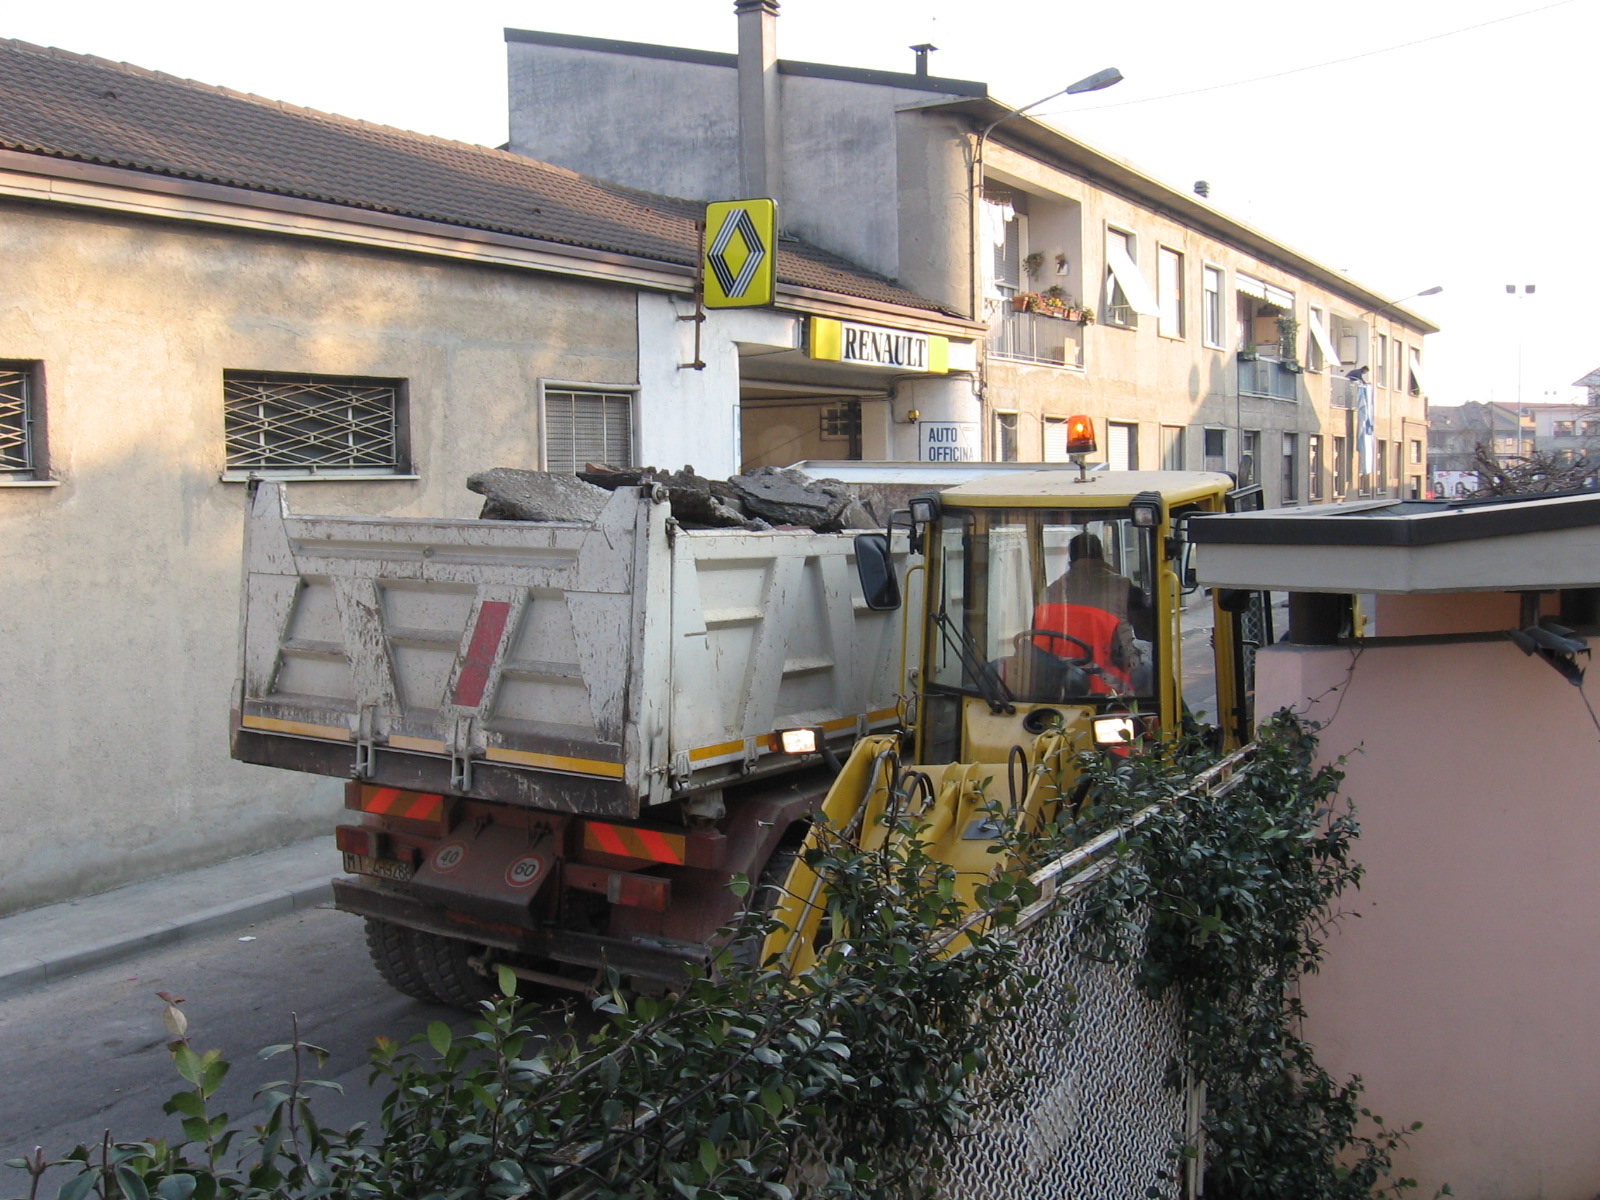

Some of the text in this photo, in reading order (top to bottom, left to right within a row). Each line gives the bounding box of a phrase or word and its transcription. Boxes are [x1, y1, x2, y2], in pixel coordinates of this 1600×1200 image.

[844, 327, 926, 368] RENAULT
[928, 427, 957, 443] AUTO
[928, 446, 974, 462] OFFICINA
[441, 850, 459, 864] 40
[515, 862, 536, 877] 60
